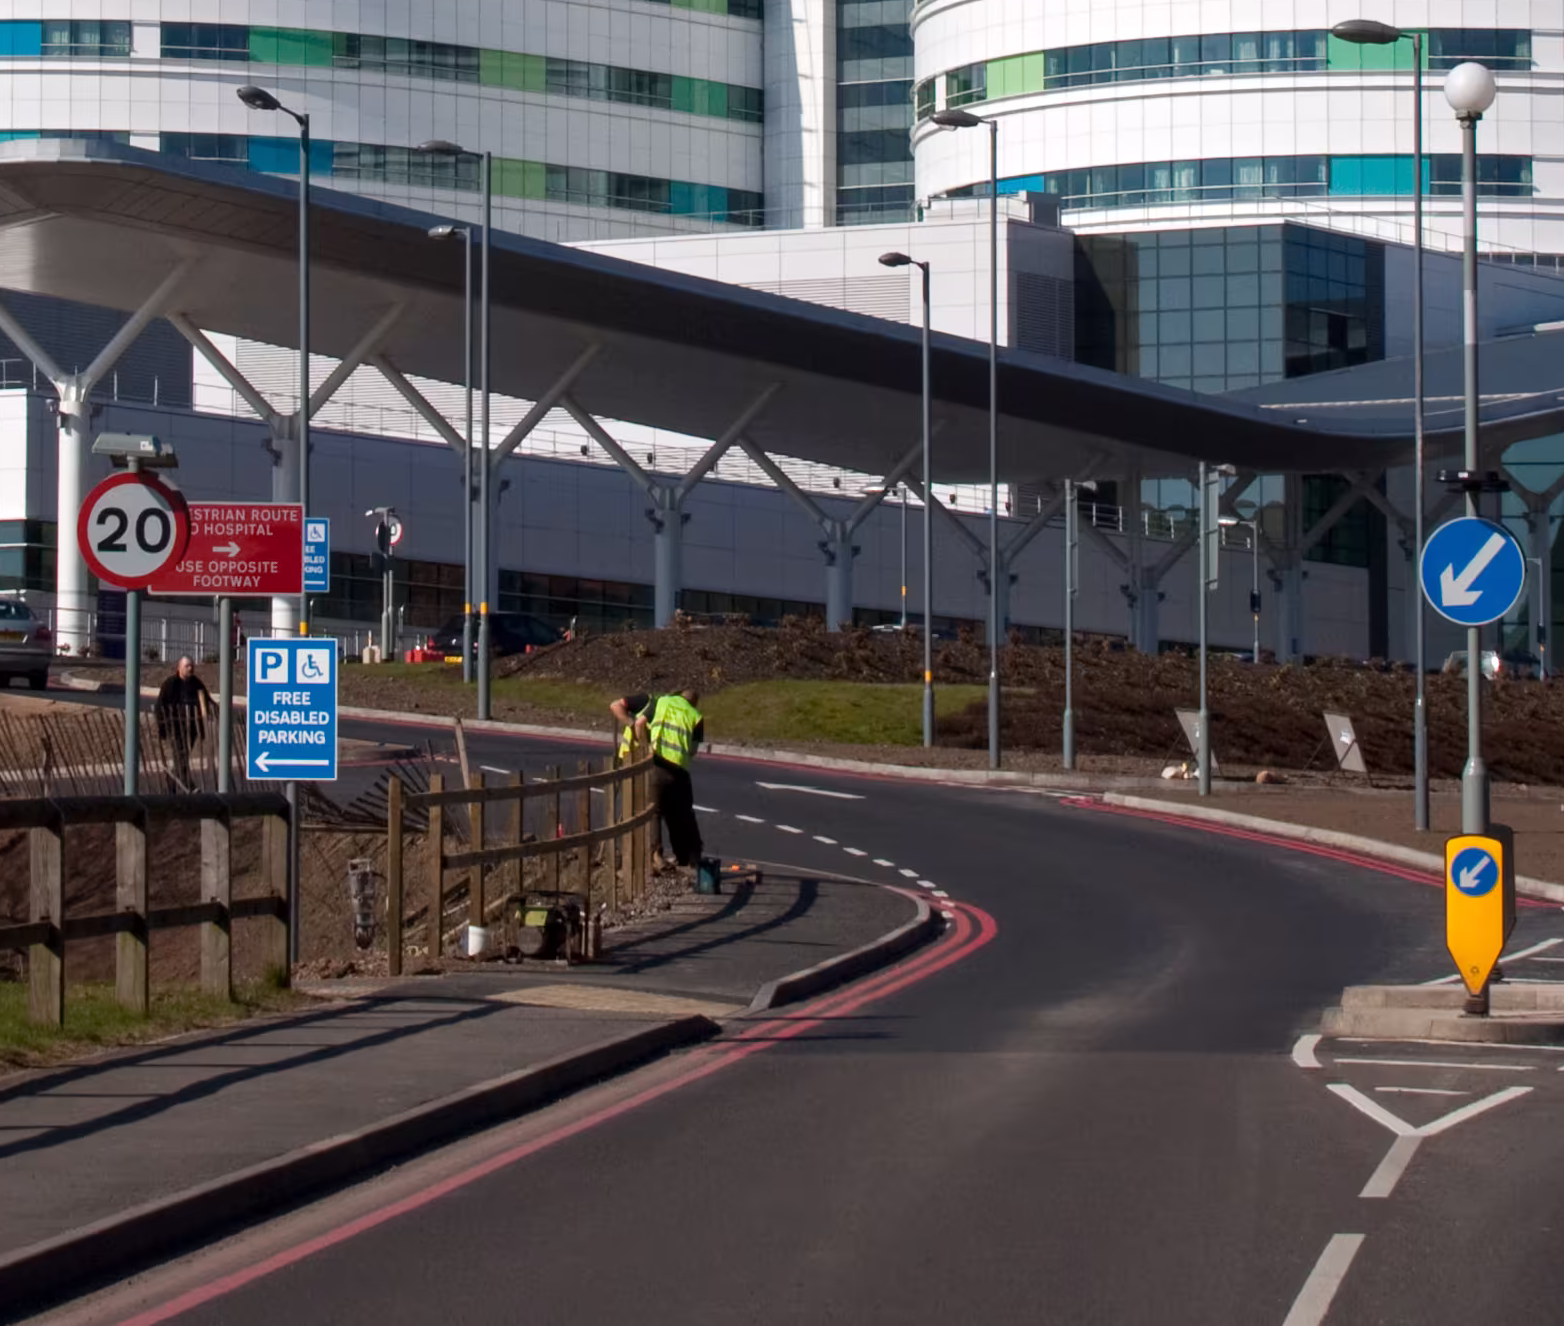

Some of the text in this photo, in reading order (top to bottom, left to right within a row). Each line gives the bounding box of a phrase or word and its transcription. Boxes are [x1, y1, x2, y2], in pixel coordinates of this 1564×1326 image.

[189, 508, 298, 522] STRIAN ROUTE
[97, 507, 171, 553] 20
[204, 523, 273, 536] HOSPITAL
[176, 561, 278, 573] USE OPPOSITE
[193, 575, 261, 587] FOOTWAY
[261, 651, 282, 680] P
[273, 691, 311, 705] FREE
[254, 710, 330, 725] DISABLED
[258, 730, 326, 744] PARKING
